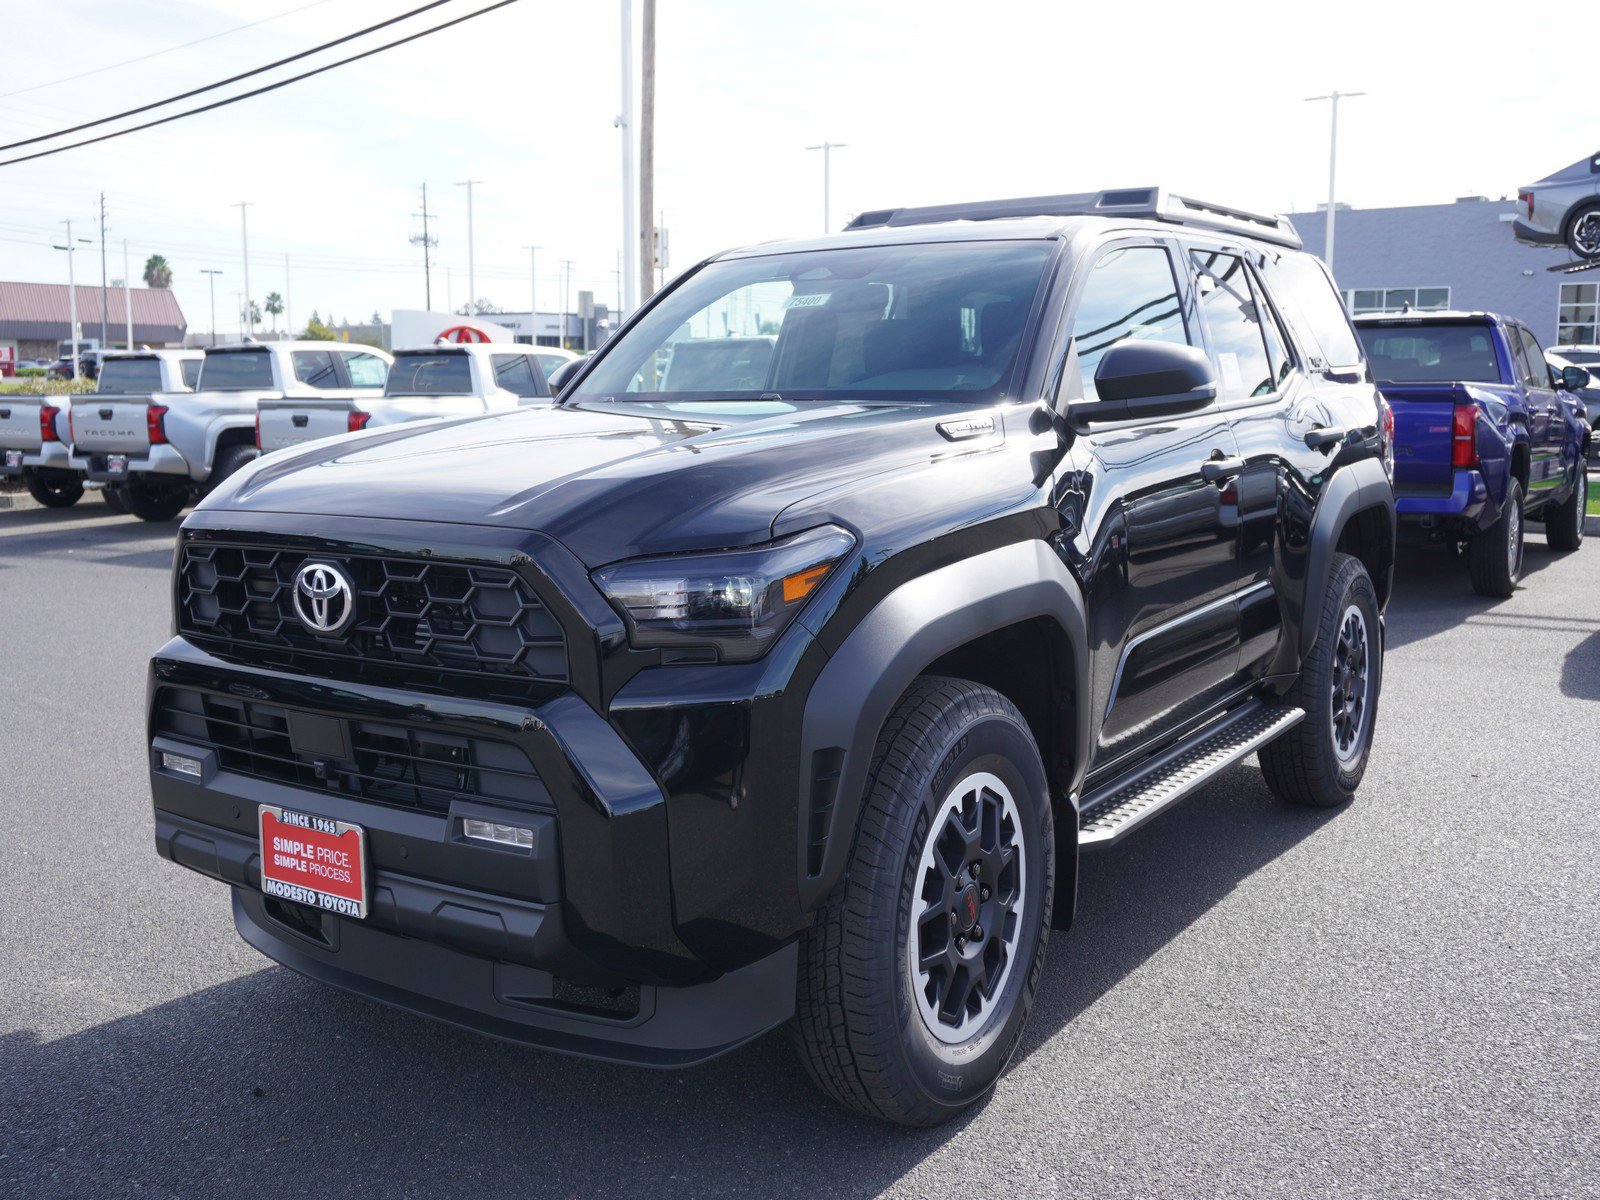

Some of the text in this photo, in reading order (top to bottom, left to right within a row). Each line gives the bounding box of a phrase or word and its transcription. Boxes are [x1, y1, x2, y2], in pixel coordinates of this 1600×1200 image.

[789, 295, 822, 306] 75400
[84, 429, 135, 437] TACOMA
[283, 811, 335, 833] SINCE 1965
[273, 837, 352, 868] SIMPLE PRICE.
[274, 854, 353, 884] SIMPLE PROCESS.
[267, 880, 360, 916] MODESTO TOYOTA
[896, 813, 928, 974] MICHELIN
